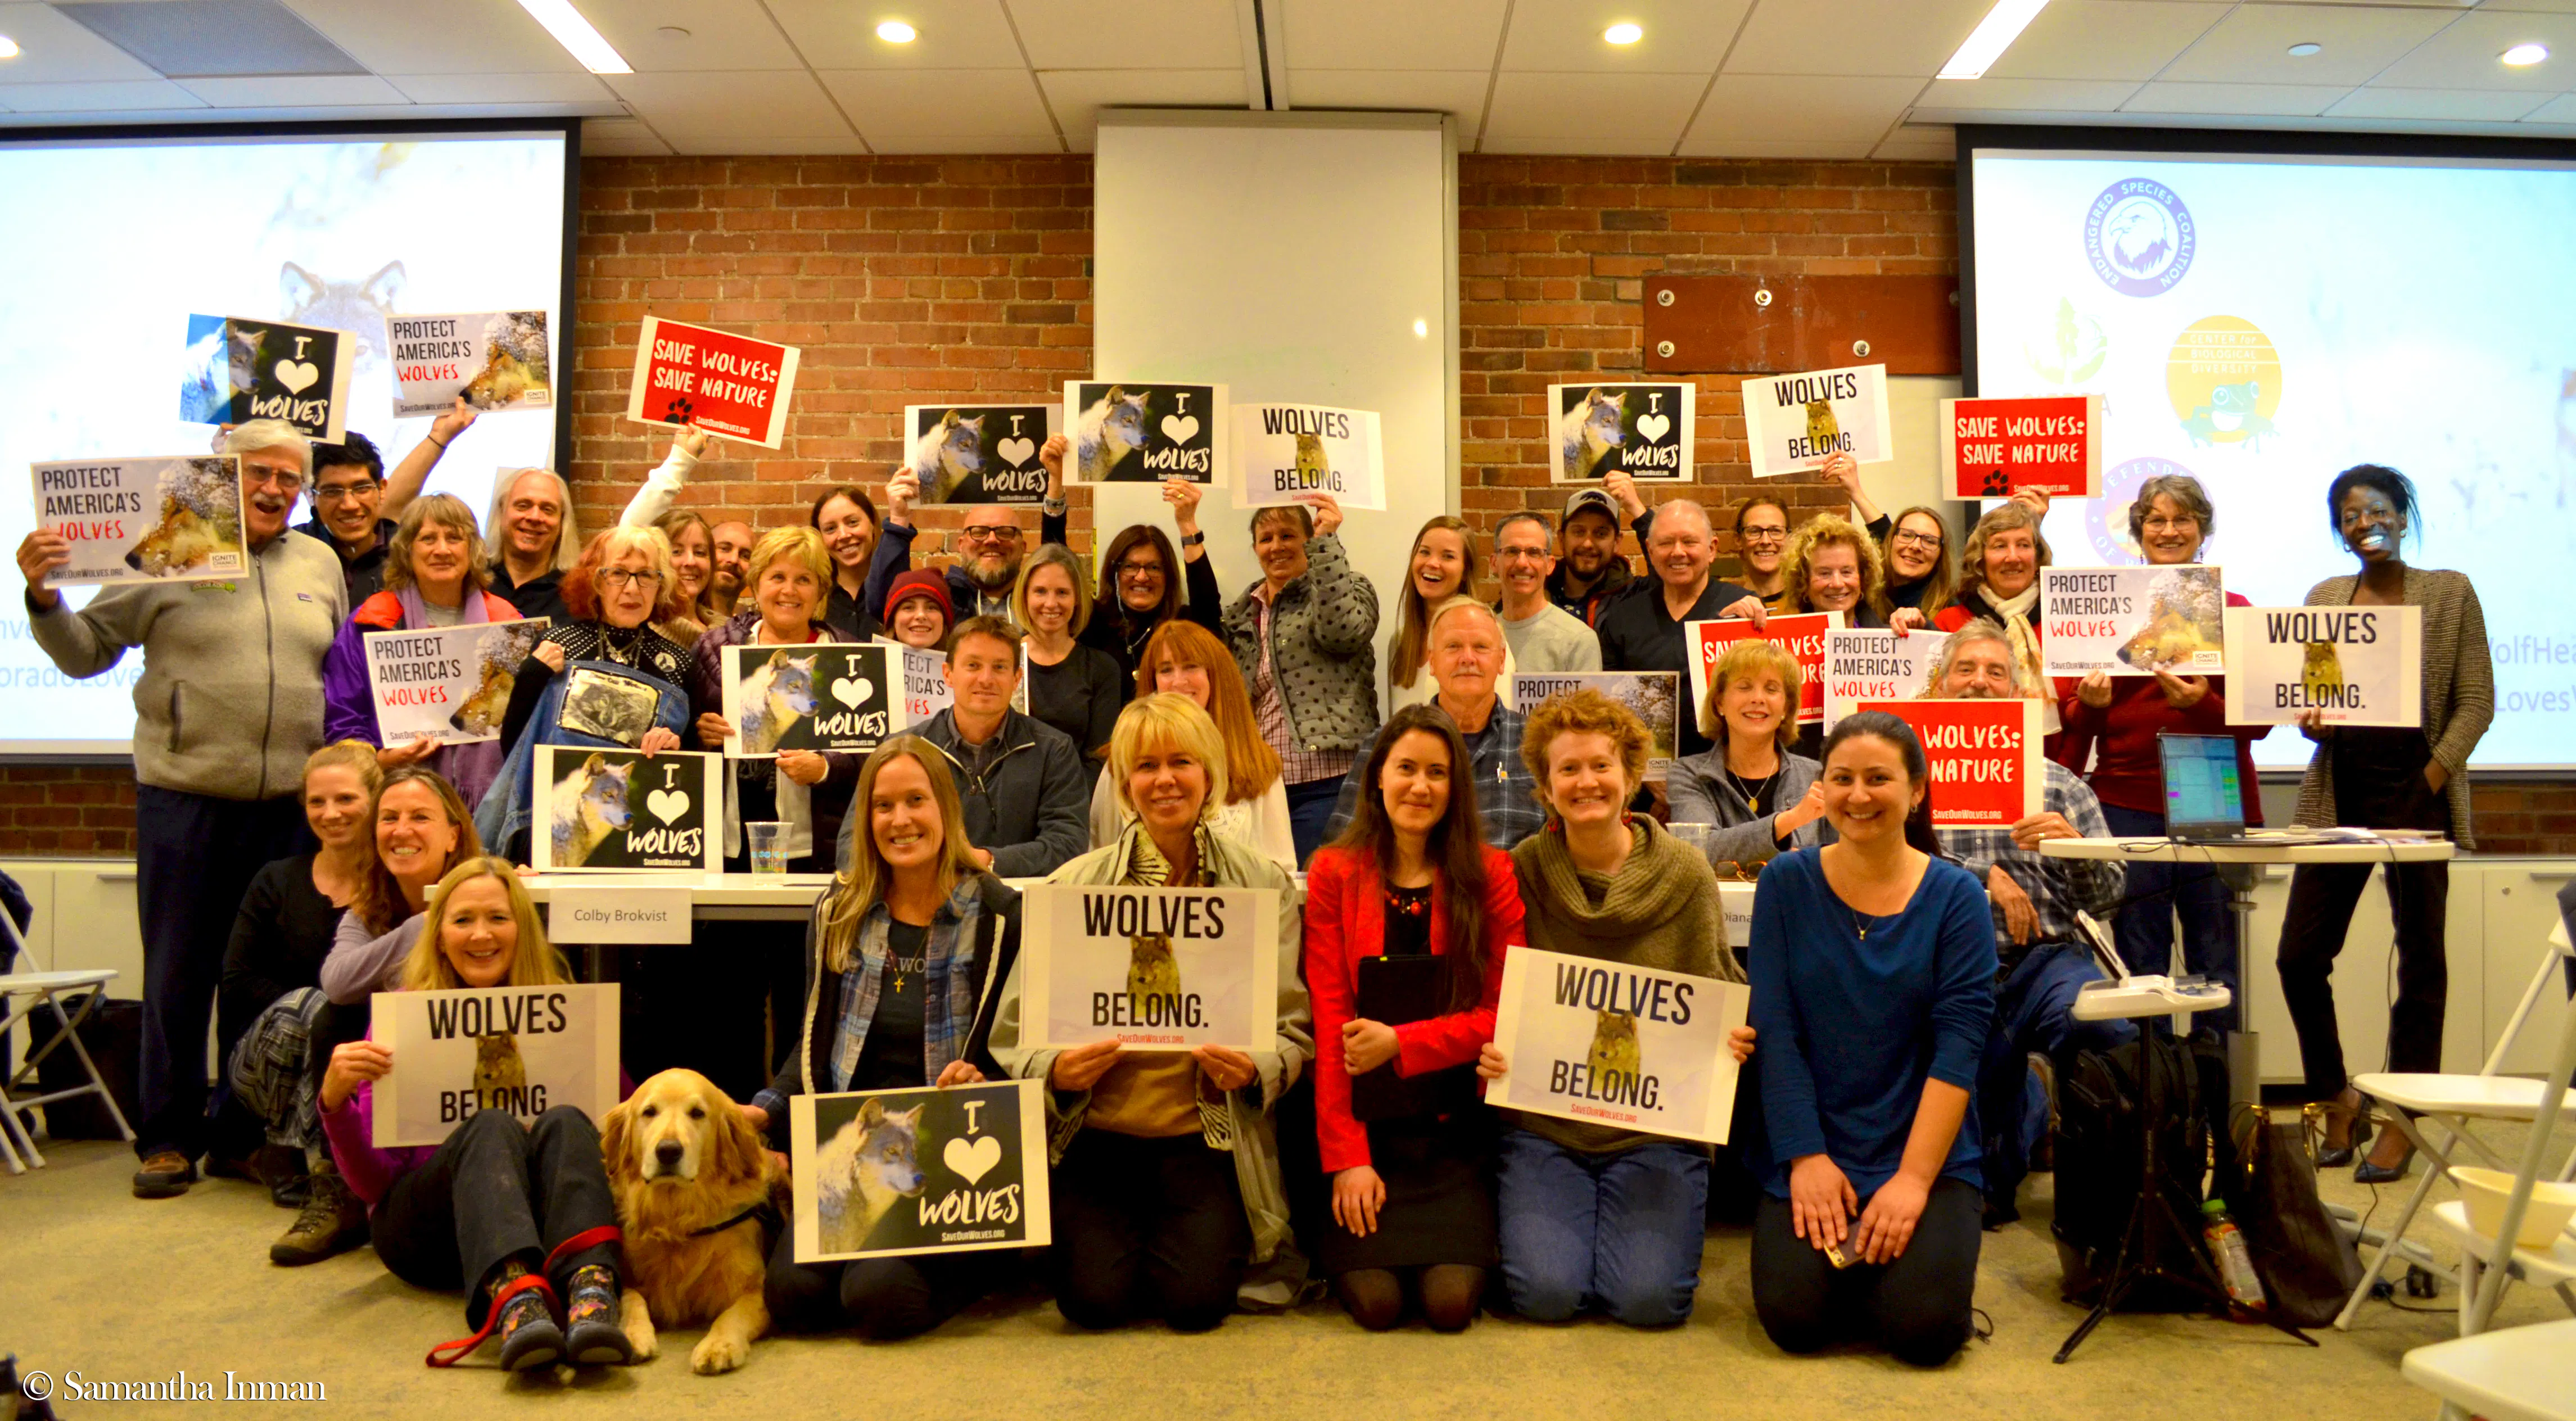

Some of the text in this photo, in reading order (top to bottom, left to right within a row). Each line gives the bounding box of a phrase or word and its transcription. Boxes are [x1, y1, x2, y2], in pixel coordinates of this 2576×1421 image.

[2087, 182, 2192, 287] ENDANGERED SPECIES COALITION
[394, 320, 456, 340] PROTECT
[2189, 334, 2257, 344] CENTER for
[295, 336, 313, 360] I
[396, 340, 471, 361] AMERICA'S
[2190, 349, 2256, 359] BIOLOGICAL
[654, 338, 778, 383] SAVE WOLVES:
[2190, 363, 2257, 374] DIVERSITY
[397, 364, 459, 382] WOLVES
[654, 367, 767, 408] SAVE NATURE
[1774, 373, 1858, 407] WOLVES
[251, 394, 328, 427] WOLVES
[1175, 392, 1191, 414] I
[1648, 393, 1662, 414] I
[1010, 414, 1025, 437] I
[1262, 408, 1349, 440] WOLVES
[1956, 415, 2085, 438] SAVE WOLVES:
[1622, 444, 1679, 468] WOLVES
[1788, 432, 1855, 459] BELONG.
[1963, 442, 2079, 464] SAVE NATURE
[1143, 447, 1210, 473] WOLVES
[41, 467, 122, 491] PROTECT
[982, 468, 1047, 492] WOLVES
[1274, 468, 1347, 492] BELONG.
[45, 492, 141, 516] AMERICA'S
[2095, 536, 2117, 558] OF
[2049, 574, 2117, 592] PROTECT
[2050, 596, 2132, 615] AMERICA'S
[2050, 620, 2116, 637] WOLVES
[2266, 612, 2377, 644] WOLVES
[374, 636, 443, 660] PROTECT
[1833, 636, 1899, 654] PROTECT
[379, 659, 462, 684] AMERICA'S
[845, 654, 862, 677] I
[1832, 658, 1912, 676] AMERICA'S
[381, 685, 448, 707] WOLVES
[1832, 681, 1896, 698] WOLVES
[2275, 683, 2366, 709] BELONG.
[814, 711, 887, 737] WOLVES
[1923, 724, 2022, 749] WOLVES:
[663, 763, 680, 789] I
[1931, 758, 2014, 783] NATURE
[627, 827, 702, 857] WOLVES
[574, 908, 667, 924] Colby Brokvist
[1083, 894, 1225, 939] WOLVES
[1555, 962, 1694, 1026] WOLVES
[427, 993, 567, 1040] WOLVES
[1092, 992, 1209, 1028] BELONG.
[1549, 1059, 1664, 1111] BELONG.
[963, 1099, 986, 1135] I
[919, 1183, 1020, 1227] WOLVES
